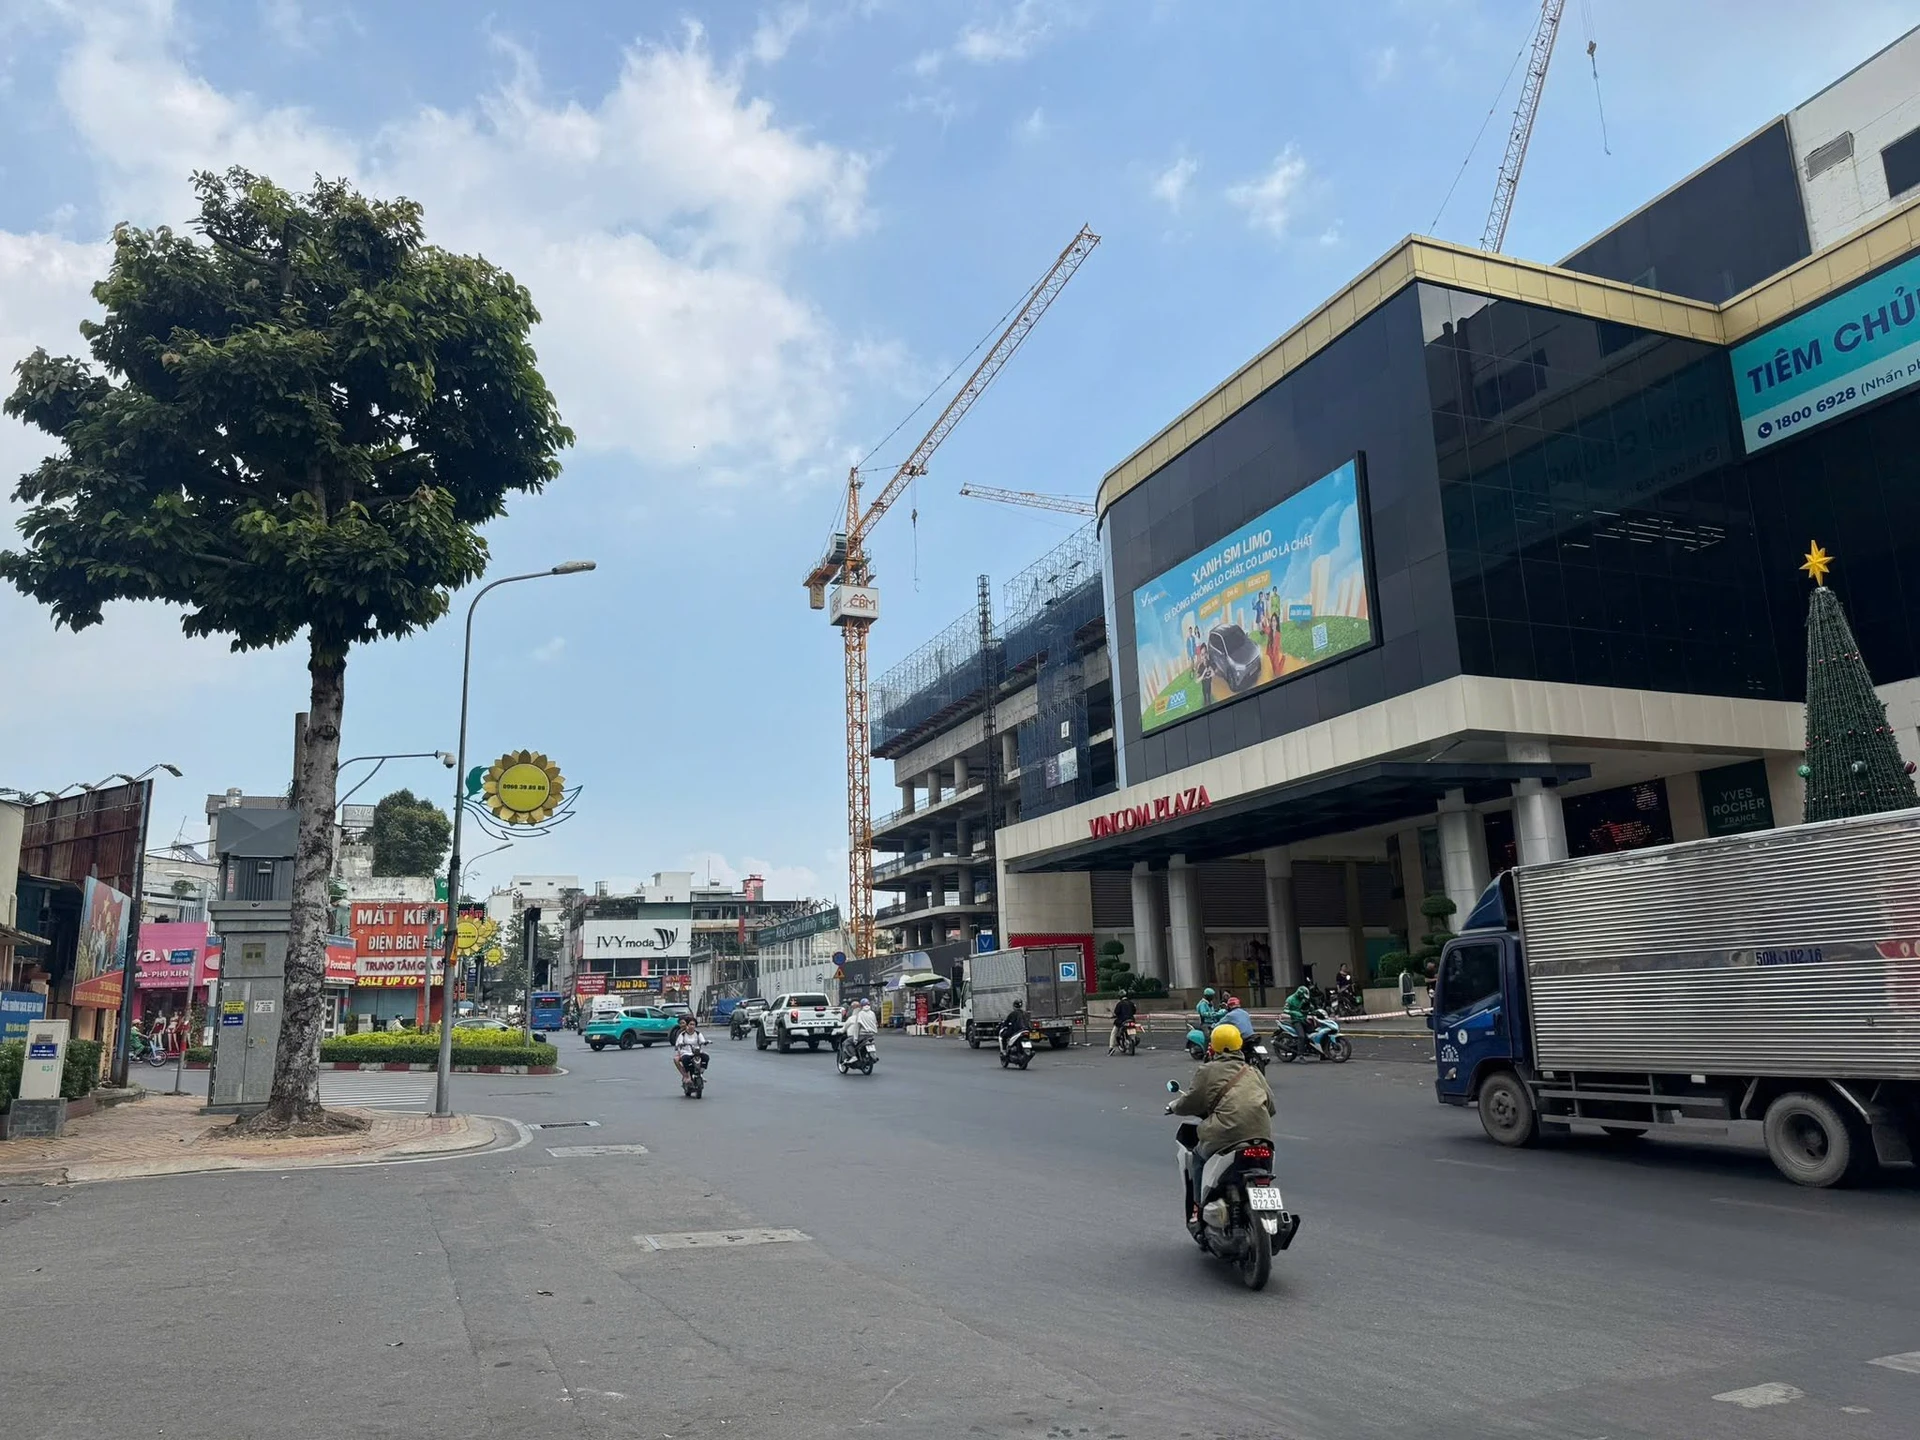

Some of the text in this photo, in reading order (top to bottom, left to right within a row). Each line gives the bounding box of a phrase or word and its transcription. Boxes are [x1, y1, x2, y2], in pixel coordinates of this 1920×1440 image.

[1747, 286, 1920, 394] TIÊM CHỦ
[1775, 406, 1812, 431] 1800
[1816, 387, 1857, 414] 6928
[1191, 529, 1272, 587] XANH SM LIMO
[1258, 547, 1278, 565] LIMO
[1721, 787, 1753, 802] YVES
[1088, 785, 1213, 840] VINCOM PLAZA
[1712, 798, 1767, 816] ROCHER
[1724, 813, 1757, 825] FRANCE
[356, 902, 397, 925] MẮT
[368, 932, 393, 953] ĐIỆN
[395, 932, 420, 950] BIÊN
[365, 961, 396, 971] TRUNG
[396, 959, 416, 971] TÂM
[357, 976, 383, 986] SALE
[385, 976, 401, 986] UP
[402, 975, 416, 986] TO
[1252, 1188, 1277, 1199] 59-X3
